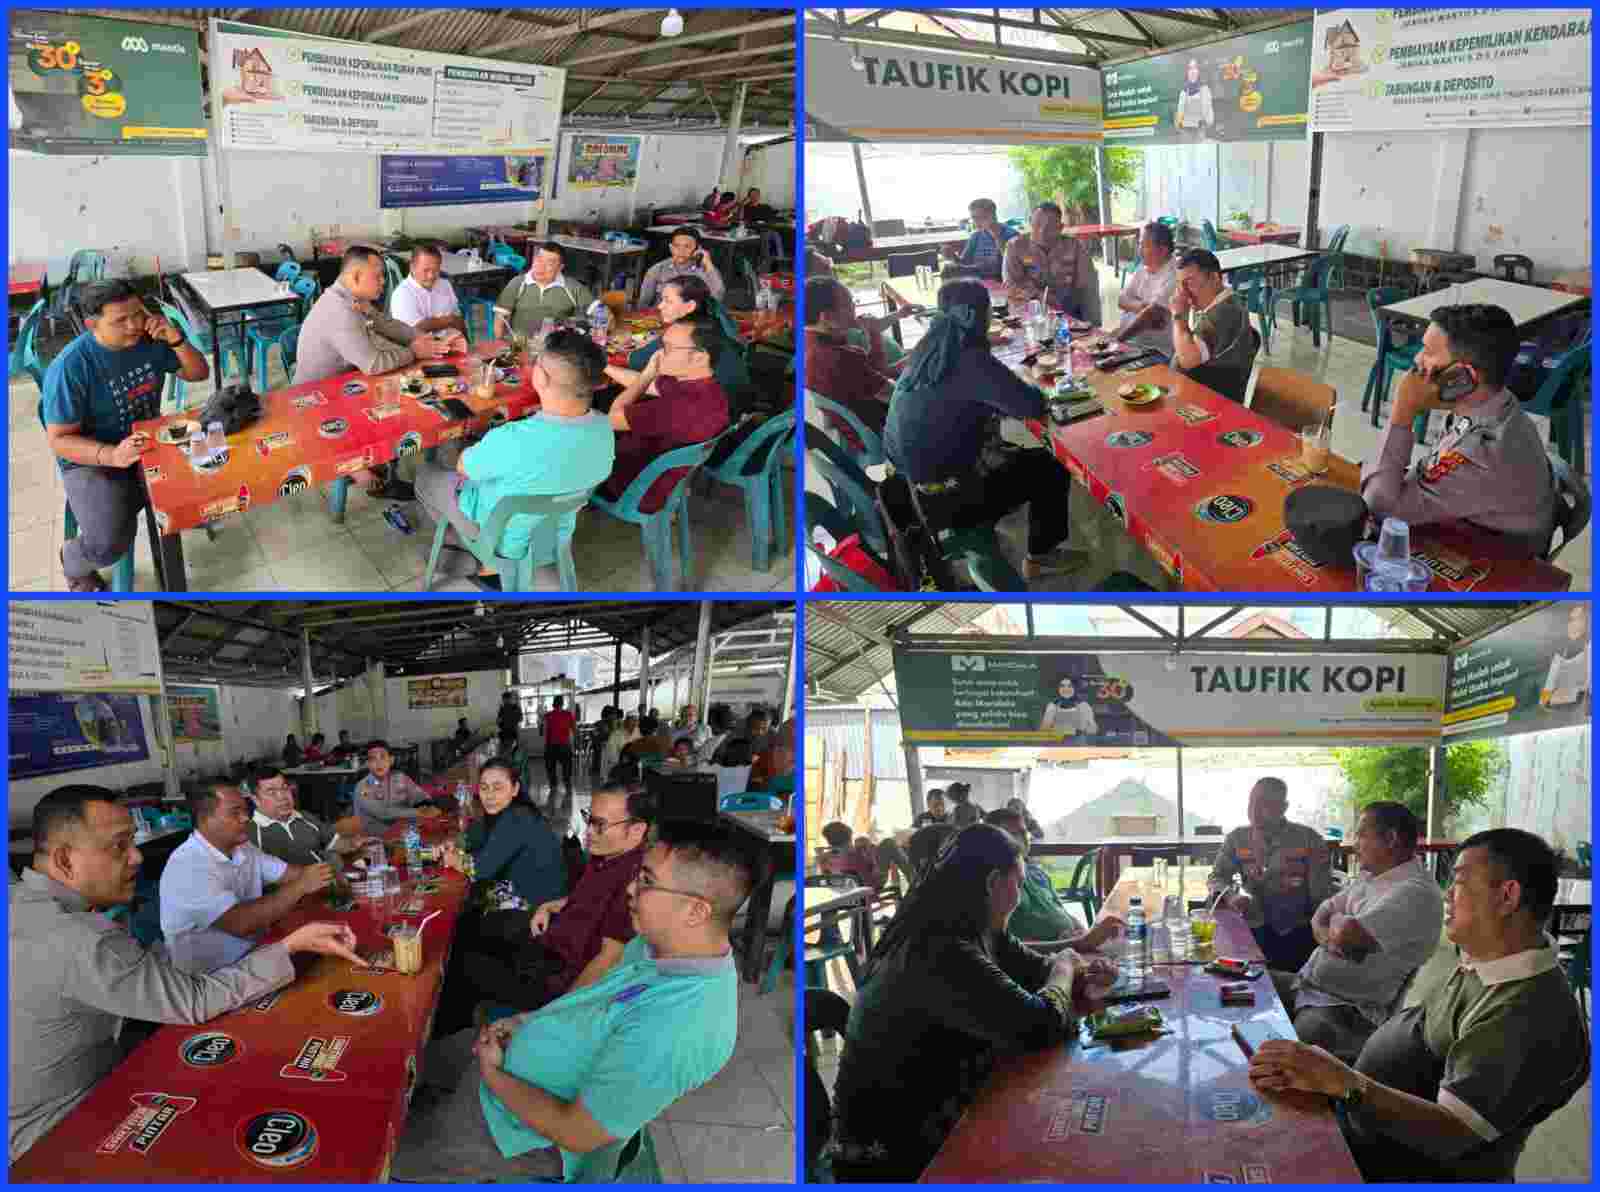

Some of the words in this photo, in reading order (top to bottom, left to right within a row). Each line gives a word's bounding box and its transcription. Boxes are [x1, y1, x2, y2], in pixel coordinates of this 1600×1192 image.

[1390, 41, 1447, 60] PEMBIAYAAN
[1448, 29, 1522, 52] KEPEMILIKAN
[863, 56, 991, 93] TAUFIK
[1000, 69, 1071, 99] KOPI
[1384, 79, 1432, 96] TABUNGAN
[1443, 75, 1495, 92] DEPOSITO
[1190, 665, 1311, 693] TAUFIK
[1322, 665, 1406, 693] KOPI
[192, 1038, 231, 1062] Cleo
[135, 1103, 177, 1146] PINTAR
[252, 1117, 298, 1155] Cleo
